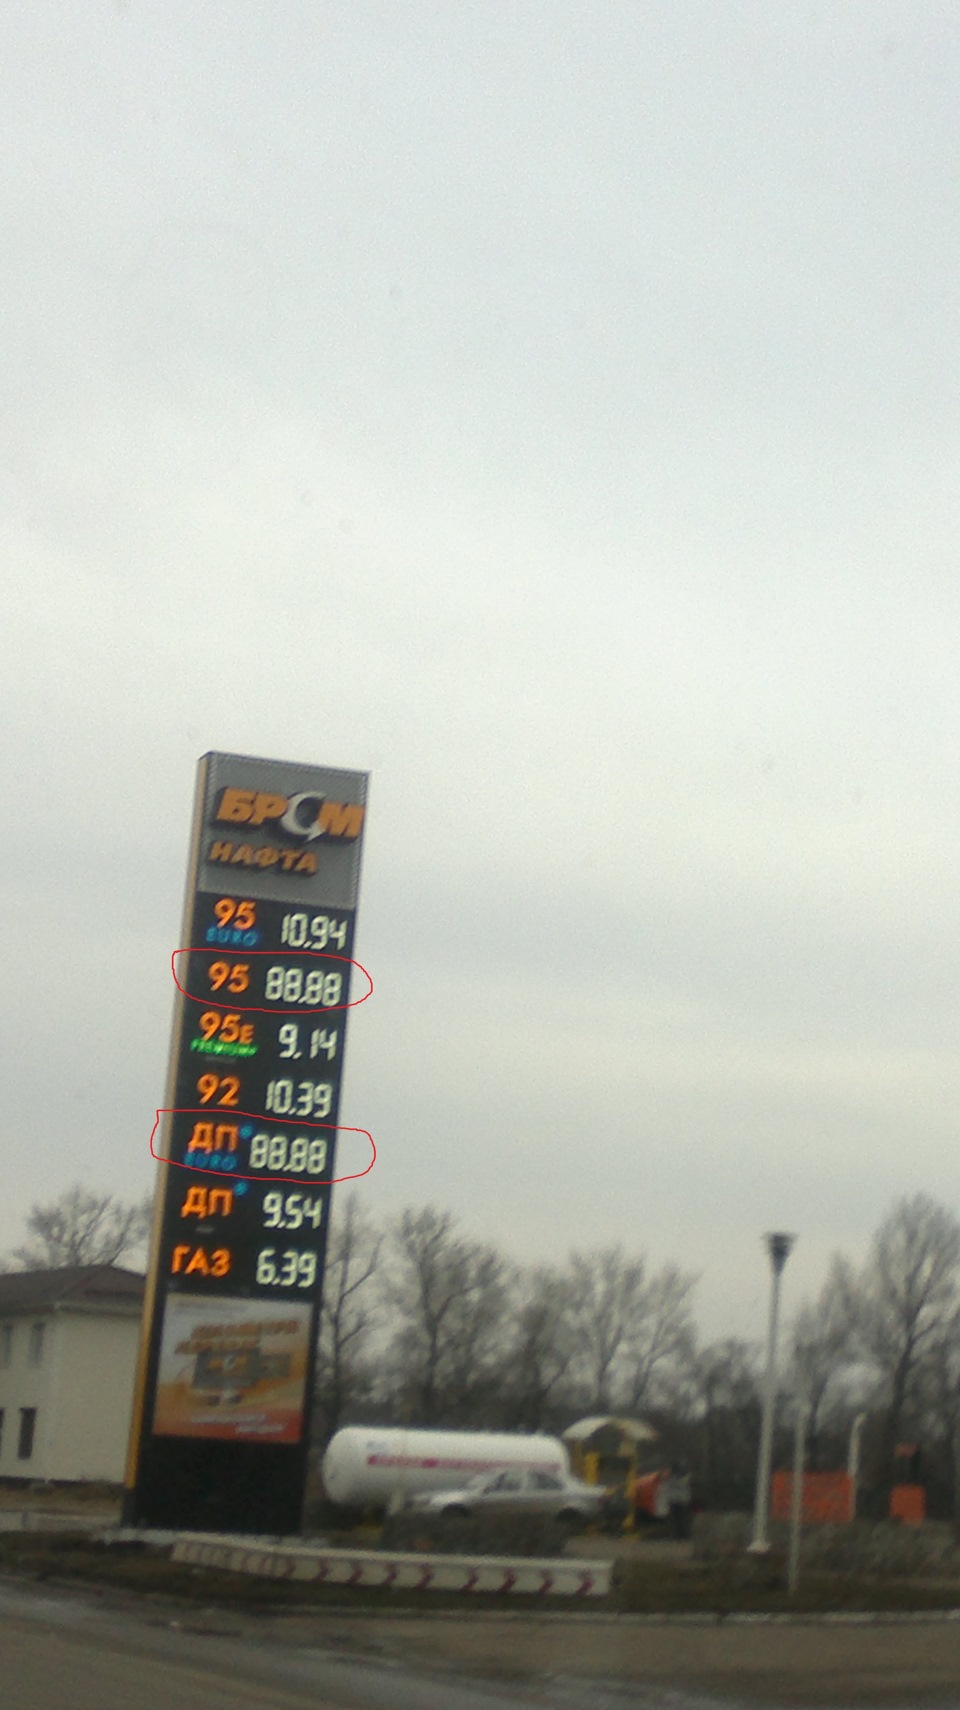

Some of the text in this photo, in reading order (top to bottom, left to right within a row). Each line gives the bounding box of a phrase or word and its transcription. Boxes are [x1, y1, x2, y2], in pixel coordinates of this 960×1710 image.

[209, 841, 318, 873] НАФТА
[206, 926, 258, 946] EURO
[214, 898, 348, 950] 95 10.94
[208, 960, 342, 1006] 95 88.88
[197, 1072, 333, 1118] 92 10.39
[184, 1152, 238, 1171] EURO
[249, 1134, 328, 1174] 88.88
[263, 1192, 322, 1230] 9.54
[171, 1245, 317, 1288] ГАЗ 6.39
